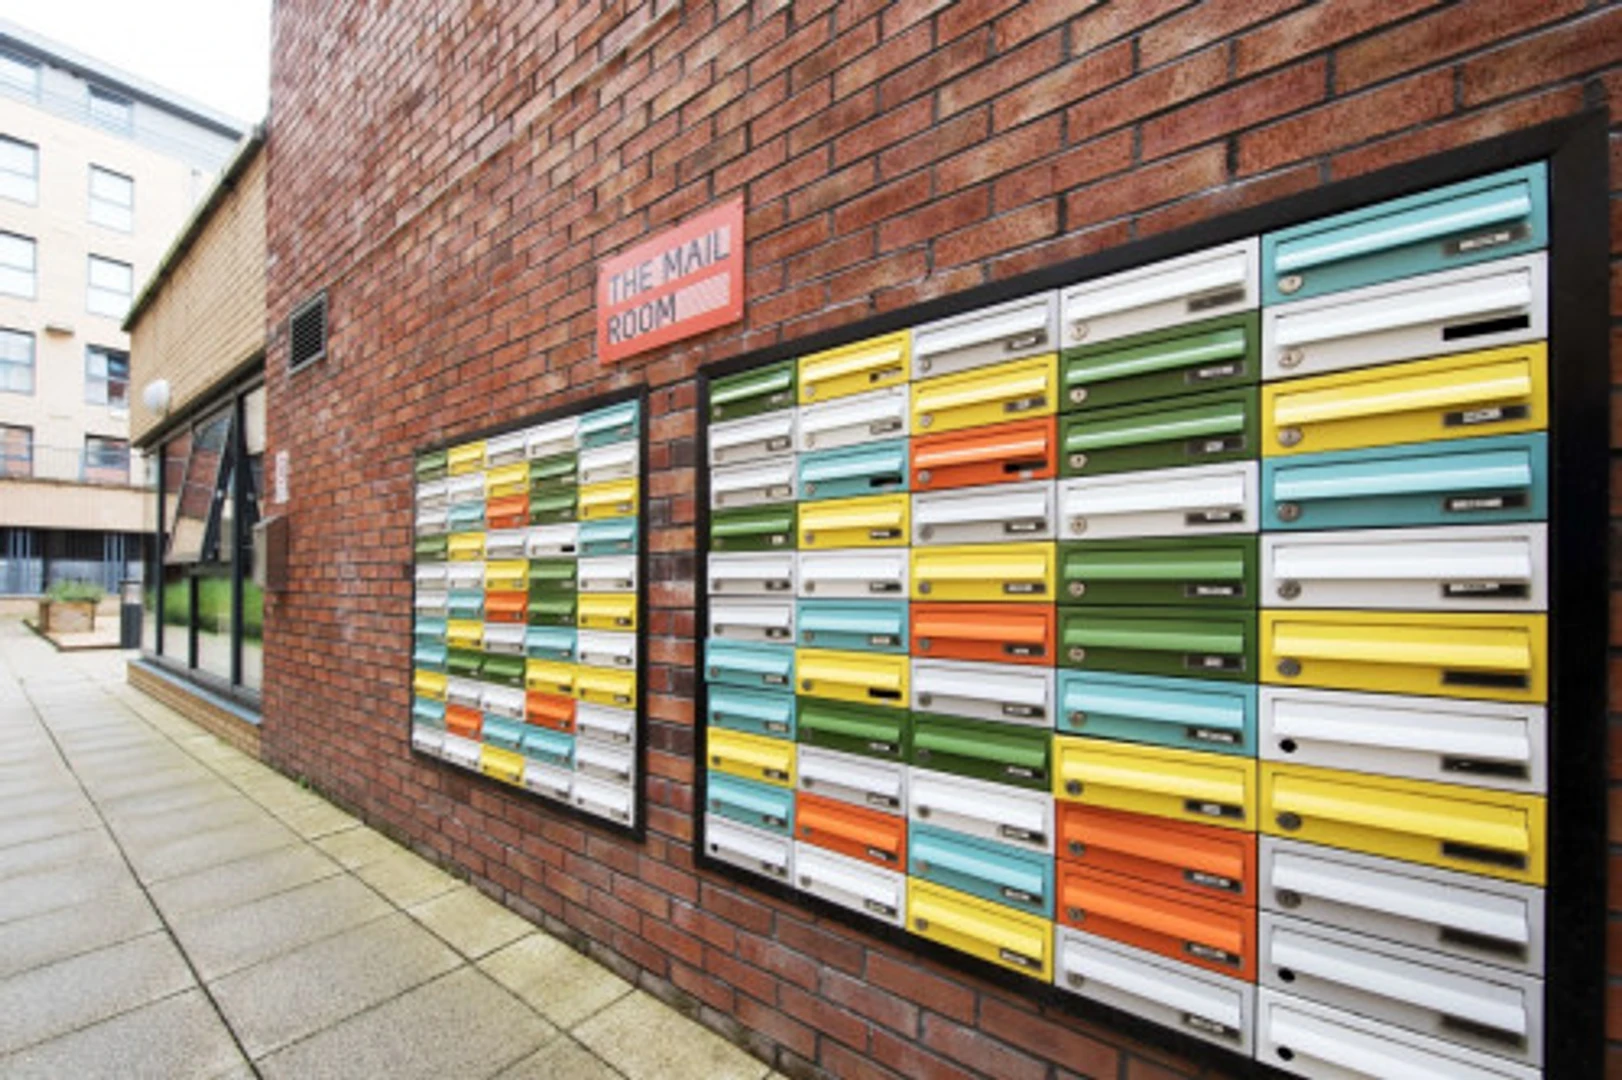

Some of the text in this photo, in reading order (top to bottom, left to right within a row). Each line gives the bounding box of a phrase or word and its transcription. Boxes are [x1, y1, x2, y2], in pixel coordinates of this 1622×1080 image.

[609, 229, 730, 305] THE MAIL
[608, 292, 676, 344] ROOM
